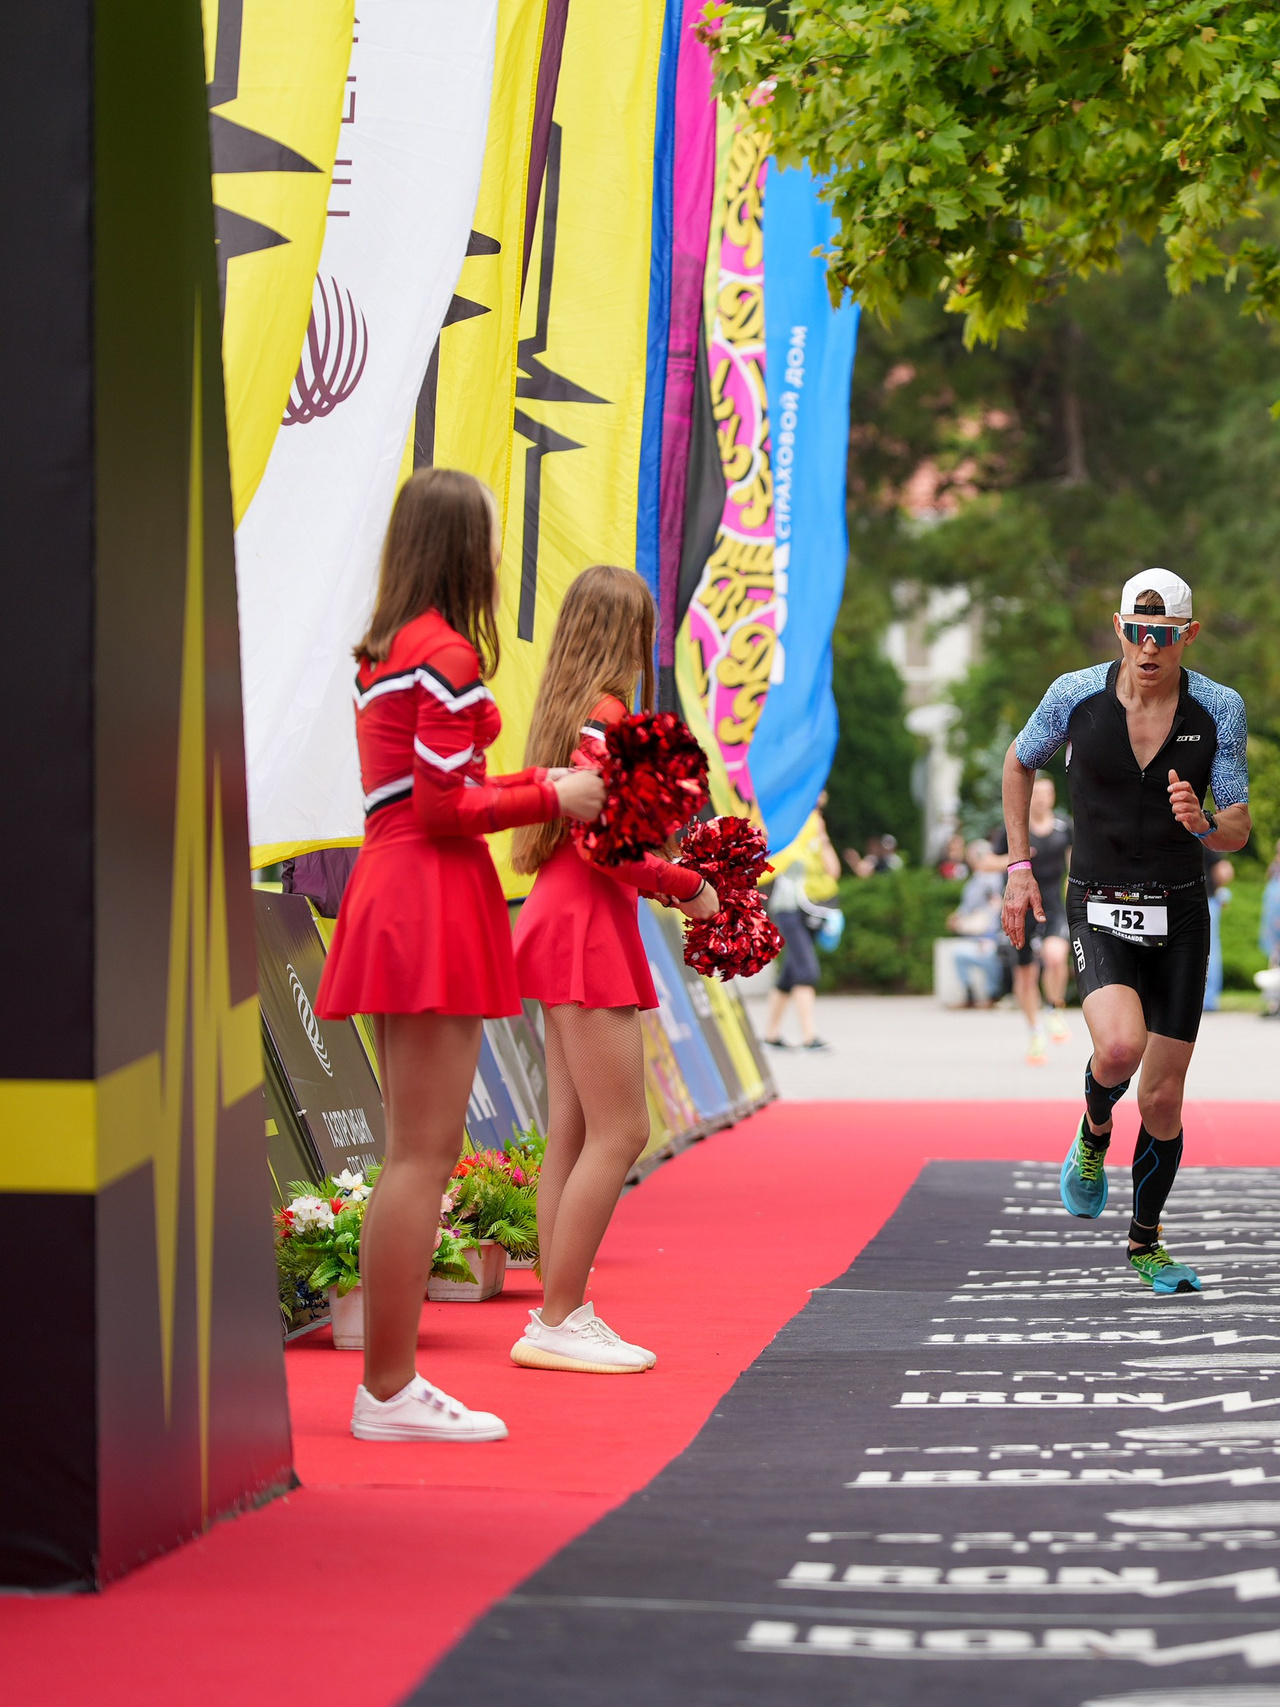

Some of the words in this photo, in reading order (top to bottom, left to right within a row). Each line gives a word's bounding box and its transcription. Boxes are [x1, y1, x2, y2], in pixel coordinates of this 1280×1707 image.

[785, 326, 807, 388] ДОМ
[775, 391, 799, 540] СТРАХОВОЙ
[1110, 909, 1145, 931] 152
[928, 1329, 1163, 1344] IRON
[898, 1391, 1166, 1406] IRON
[856, 1468, 1165, 1485] IRON
[785, 1561, 1159, 1590] IRON
[744, 1621, 1158, 1654] IRON
